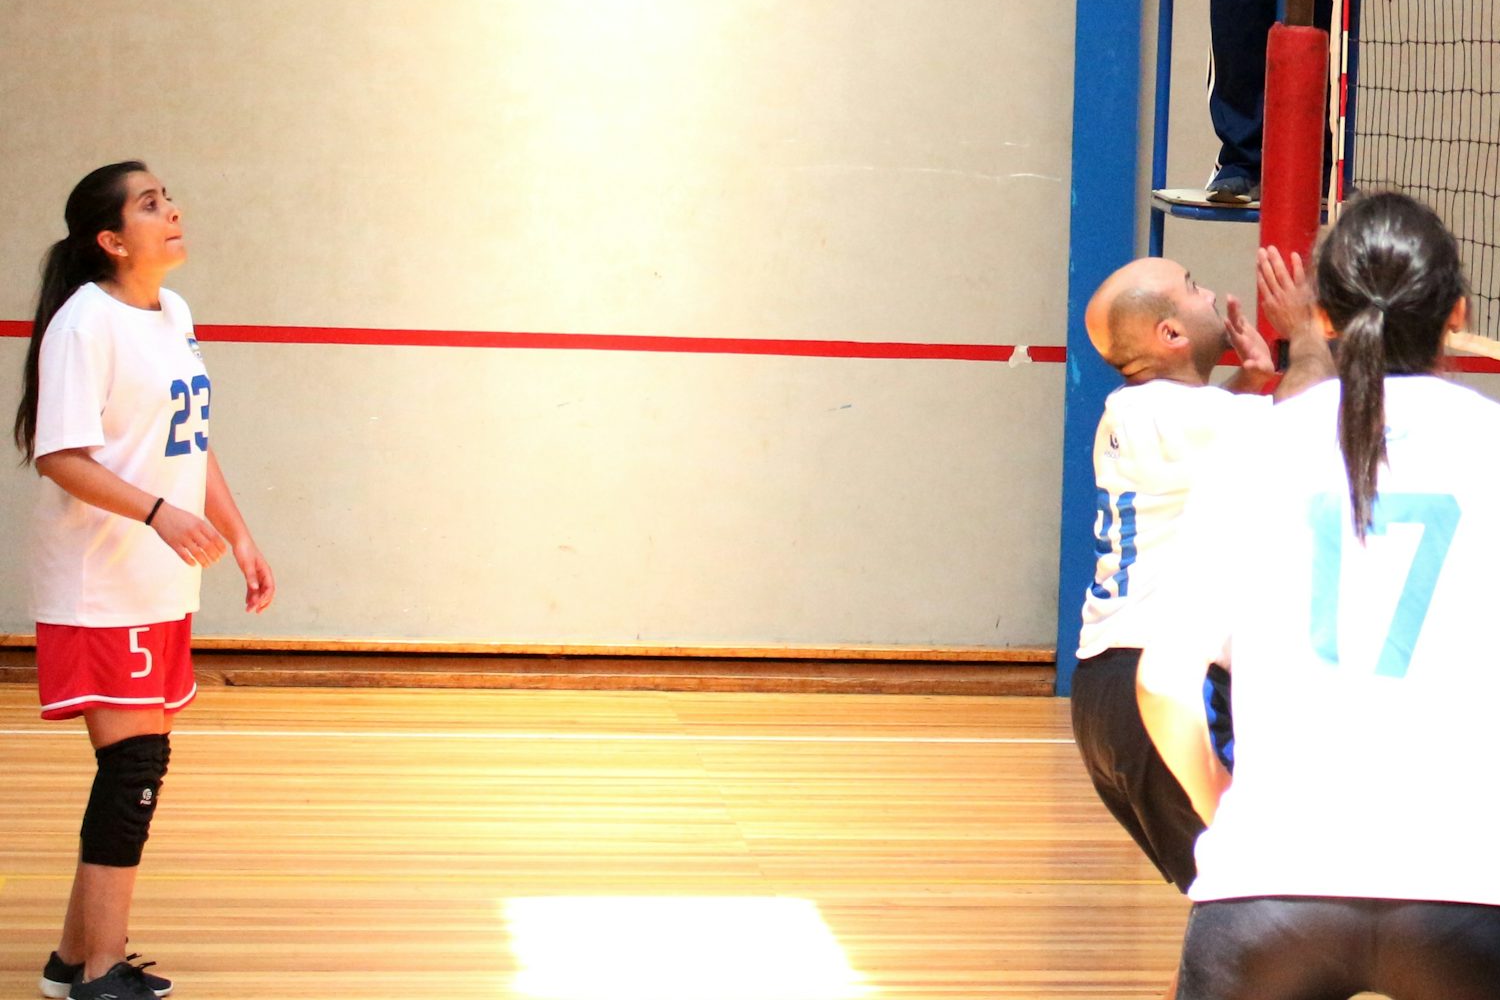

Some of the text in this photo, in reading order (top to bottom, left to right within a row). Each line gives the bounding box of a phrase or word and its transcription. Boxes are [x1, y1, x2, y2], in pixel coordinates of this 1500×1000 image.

[164, 374, 211, 457] 23
[1306, 491, 1462, 679] 17
[129, 626, 153, 679] 5
